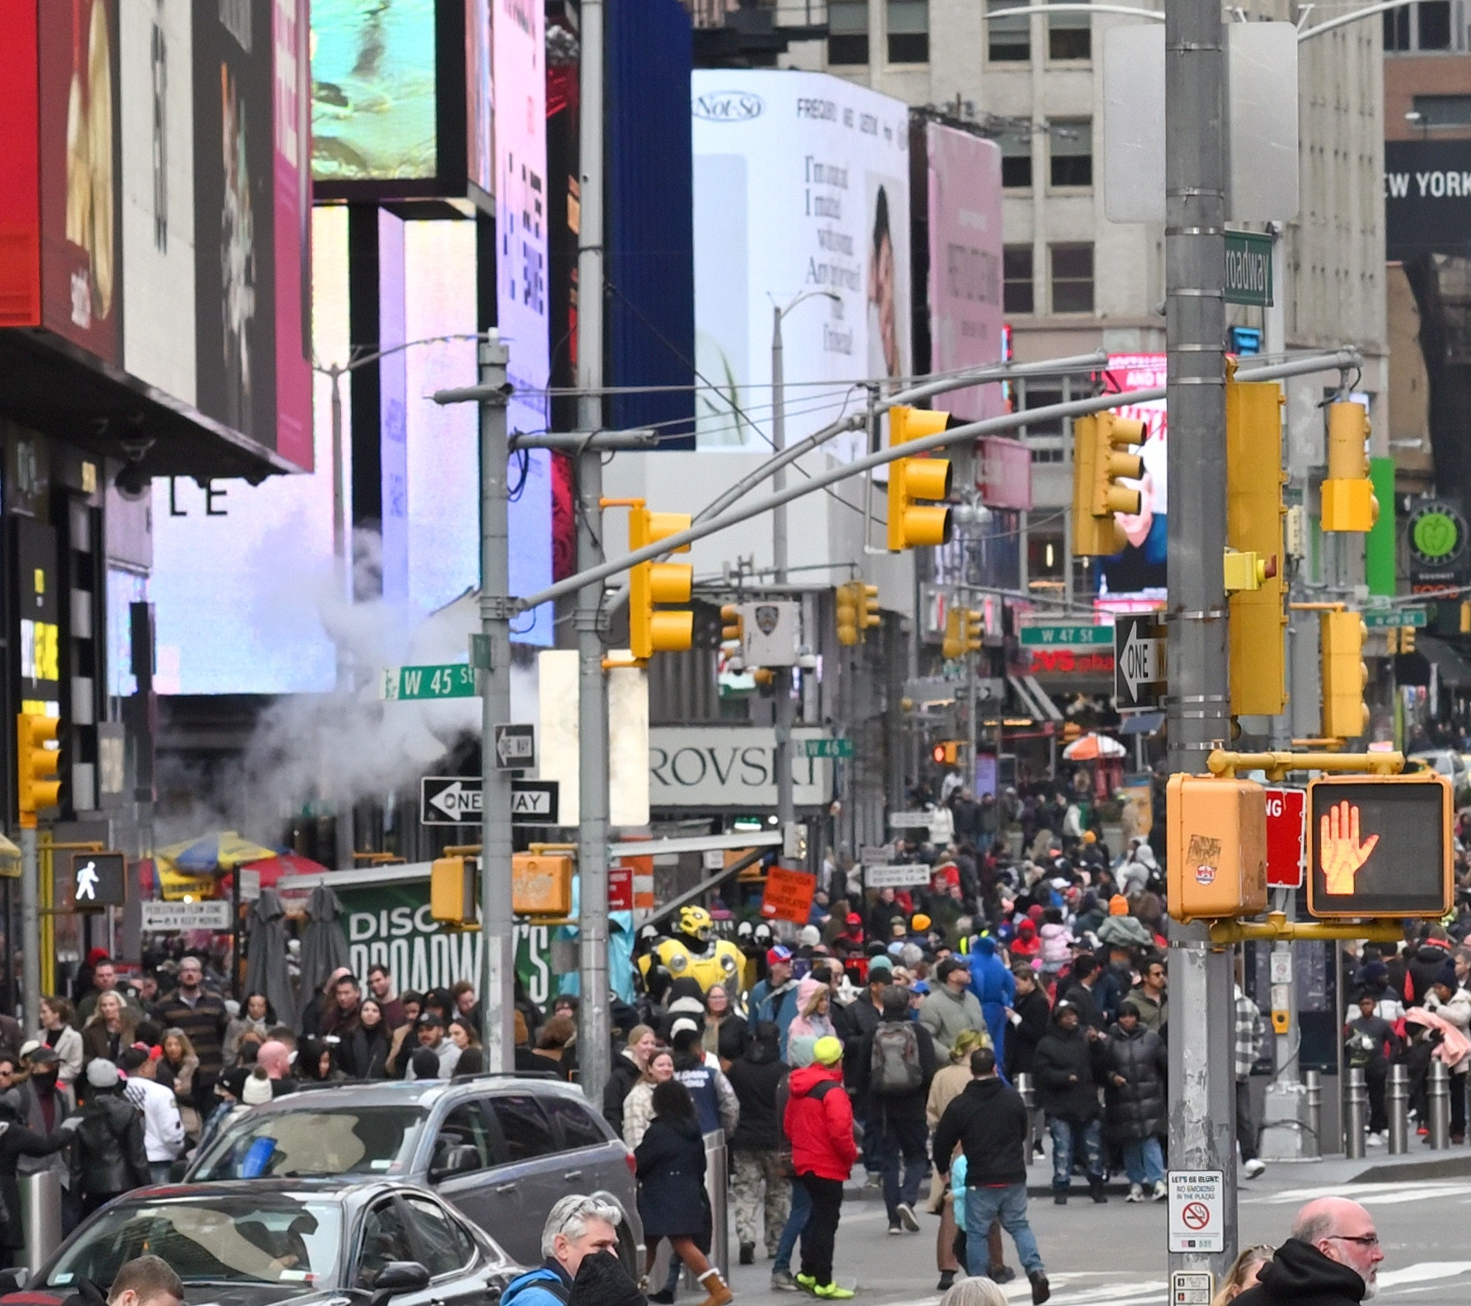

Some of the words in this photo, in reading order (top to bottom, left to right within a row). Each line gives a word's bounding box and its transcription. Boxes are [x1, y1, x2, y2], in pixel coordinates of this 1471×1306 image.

[1226, 239, 1269, 306] roadway
[1041, 630, 1055, 643] W
[1058, 629, 1074, 643] 47
[1080, 629, 1093, 643] St
[1031, 650, 1076, 673] CVS
[1127, 643, 1149, 679] ONE
[404, 671, 422, 696] W
[431, 669, 453, 695] 45
[459, 666, 475, 685] St
[444, 792, 482, 811] ONE
